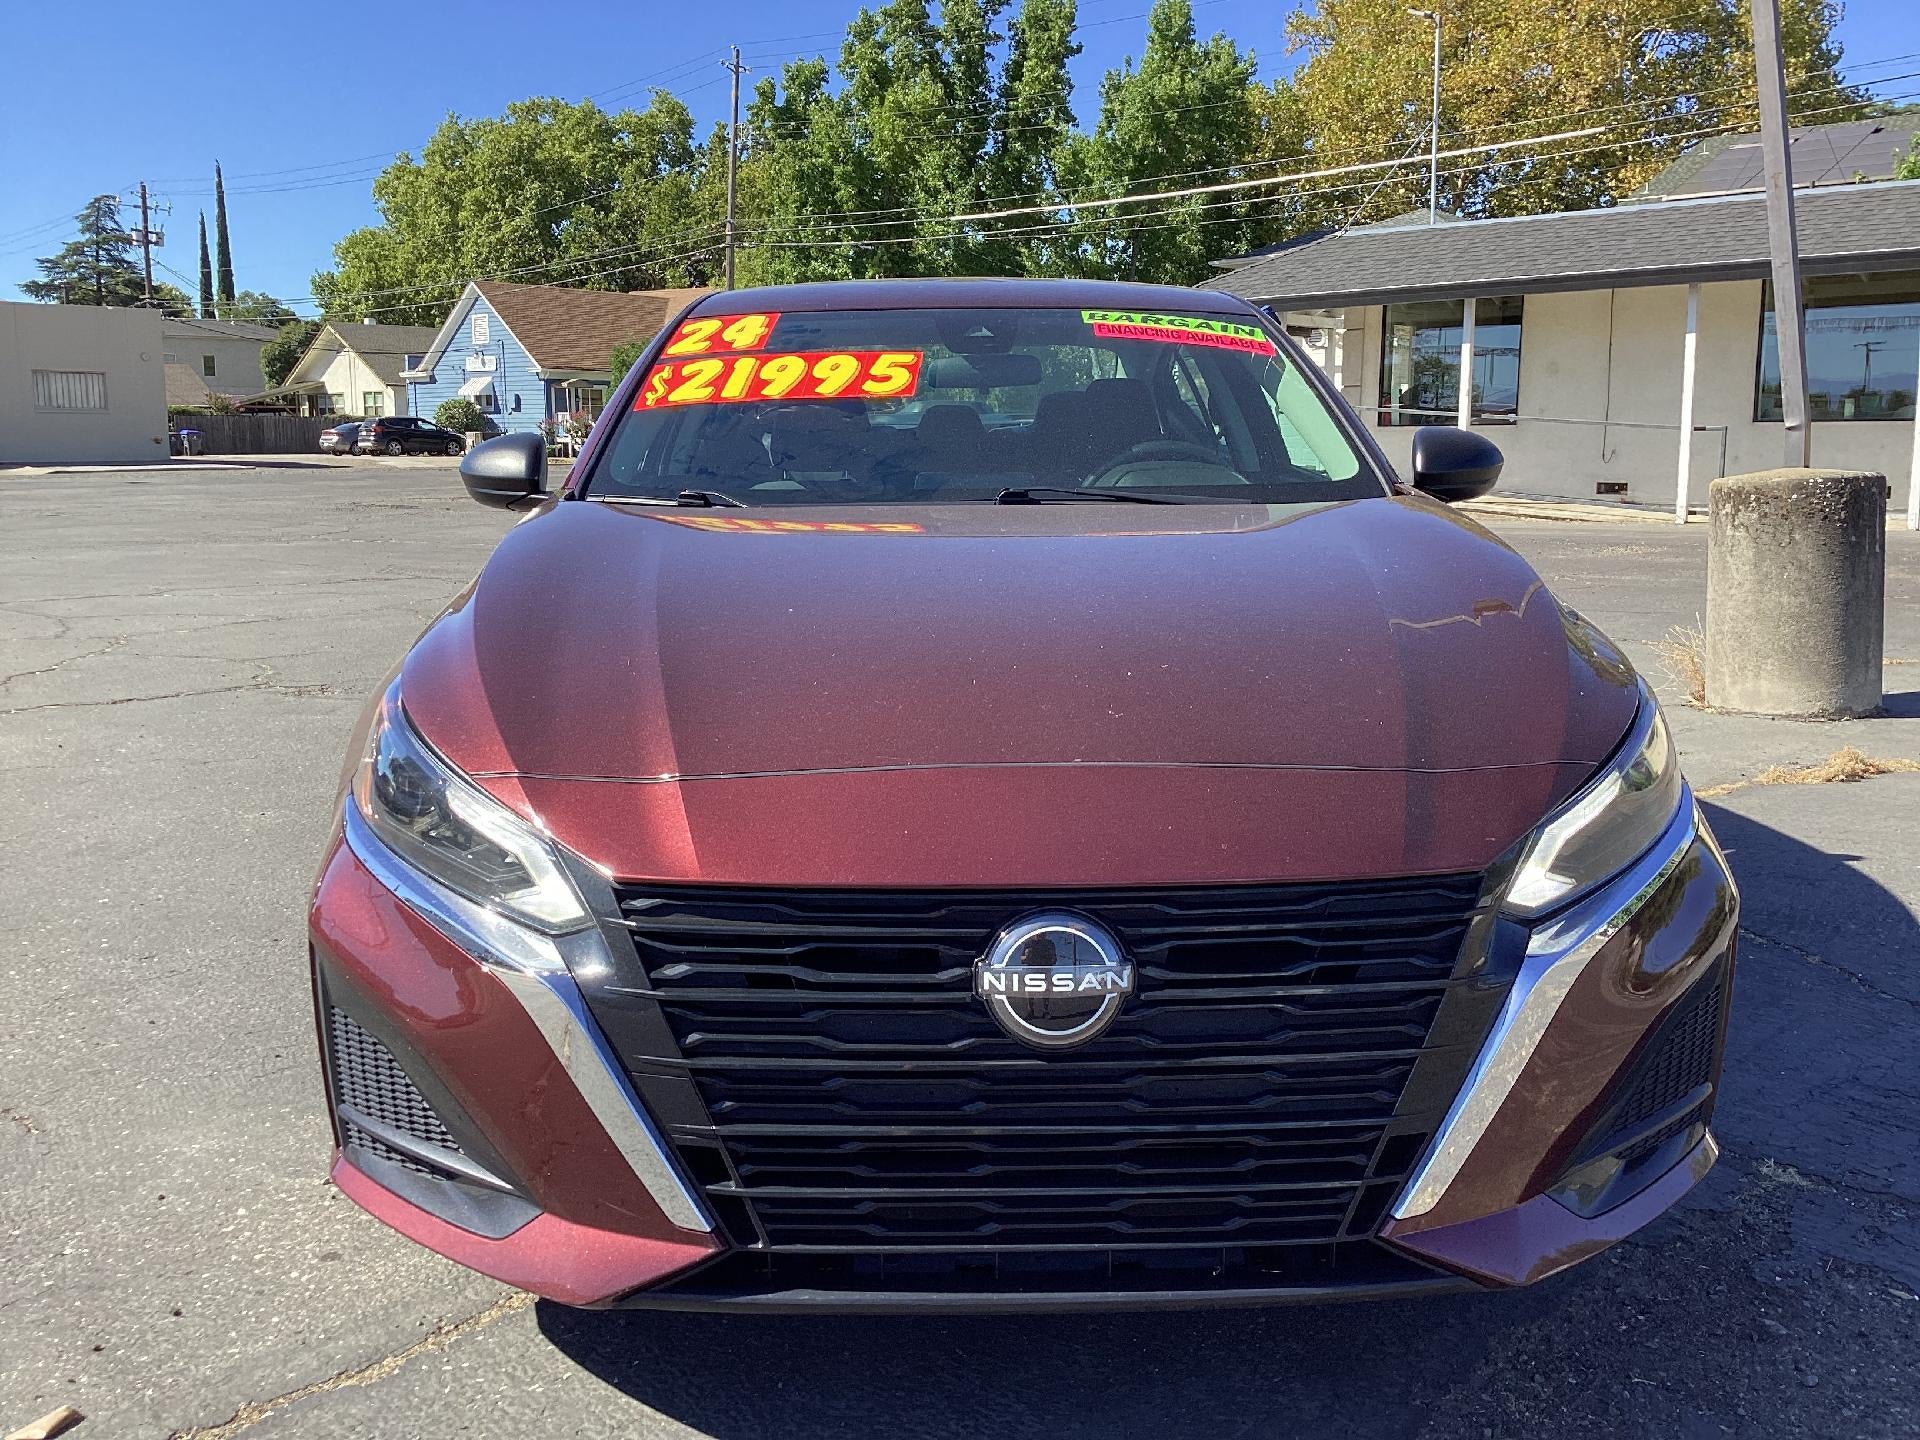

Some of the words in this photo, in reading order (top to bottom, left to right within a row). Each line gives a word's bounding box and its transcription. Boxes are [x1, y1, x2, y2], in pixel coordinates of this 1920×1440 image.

[666, 315, 768, 355] 24
[1087, 311, 1256, 337] BARGAIN
[1097, 323, 1182, 340] FINANCING
[1185, 331, 1268, 352] AVAILABLE
[645, 354, 918, 406] $21995
[983, 970, 1129, 992] NISSAN
